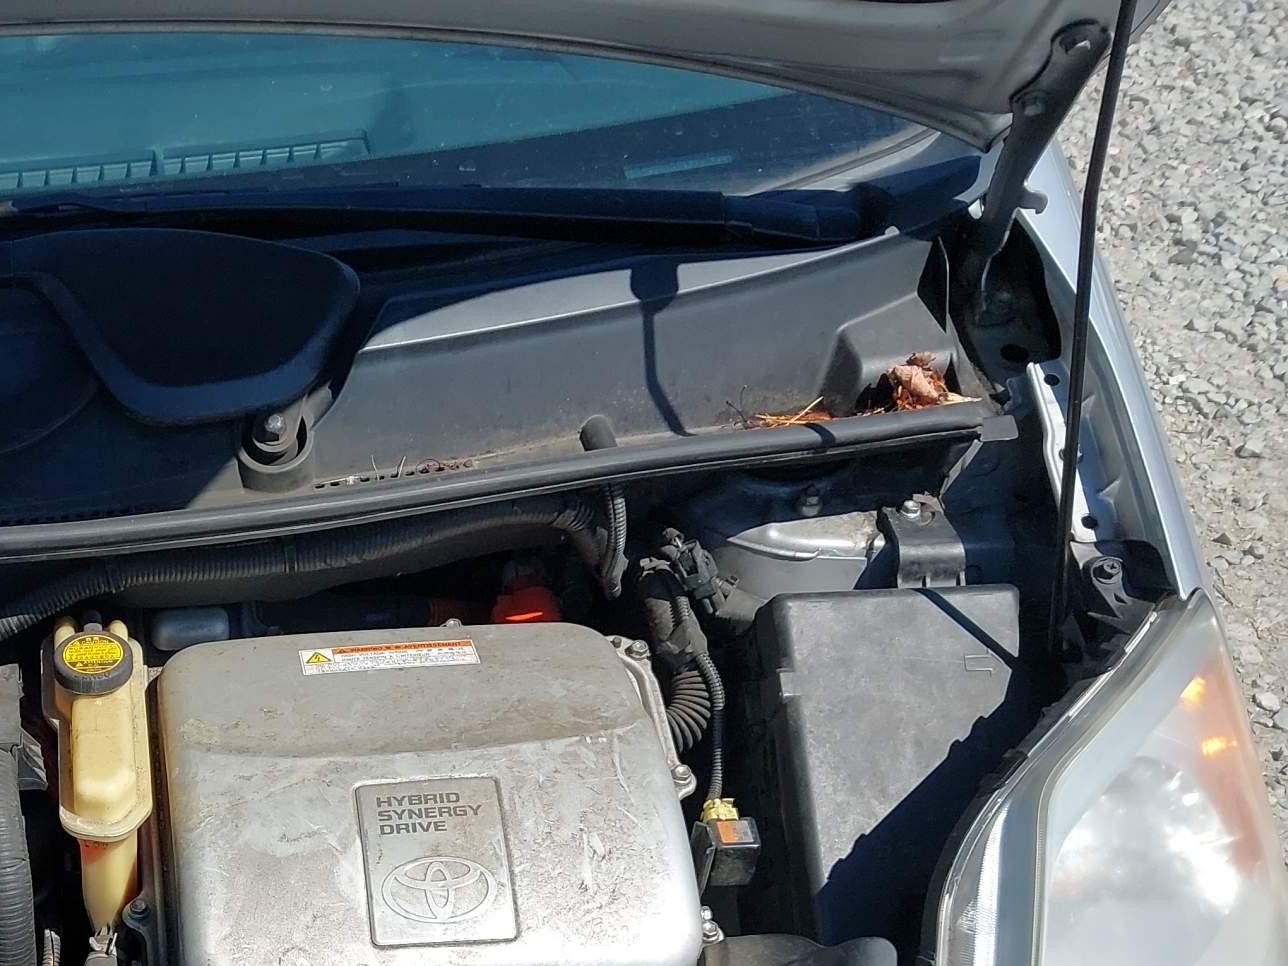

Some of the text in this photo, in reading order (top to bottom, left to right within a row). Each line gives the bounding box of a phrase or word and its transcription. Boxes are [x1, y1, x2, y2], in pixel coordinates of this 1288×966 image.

[376, 792, 460, 808] HYBRID
[377, 804, 482, 822] SYNERGY
[379, 820, 447, 836] DRIVE
